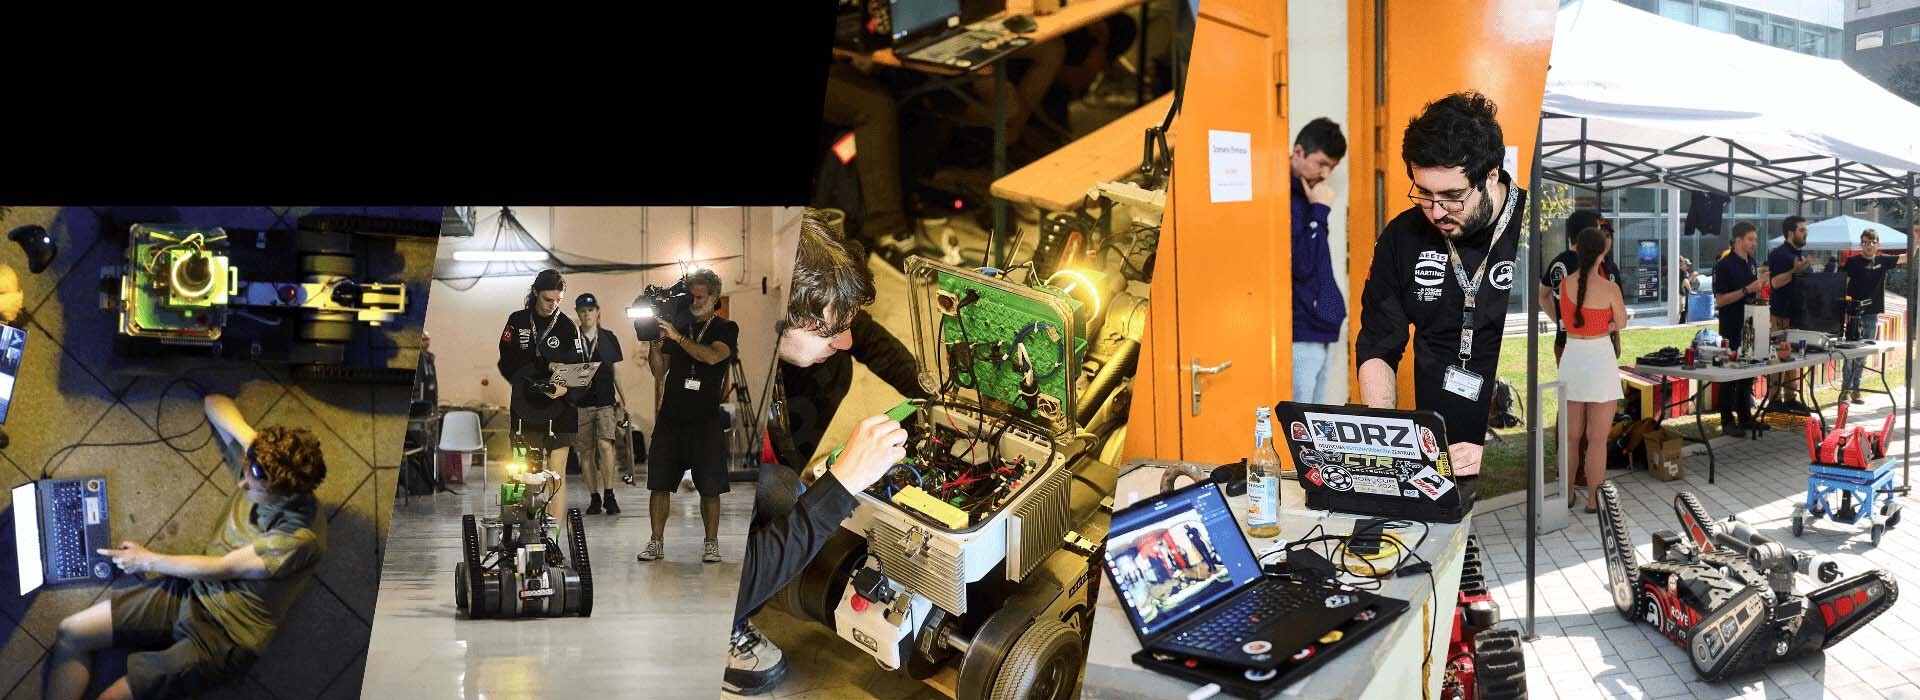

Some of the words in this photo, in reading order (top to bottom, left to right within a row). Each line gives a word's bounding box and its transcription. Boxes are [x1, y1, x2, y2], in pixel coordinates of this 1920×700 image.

[1414, 269, 1445, 277] HARTING
[1335, 421, 1414, 449] DRZ
[1344, 453, 1394, 469] CTR
